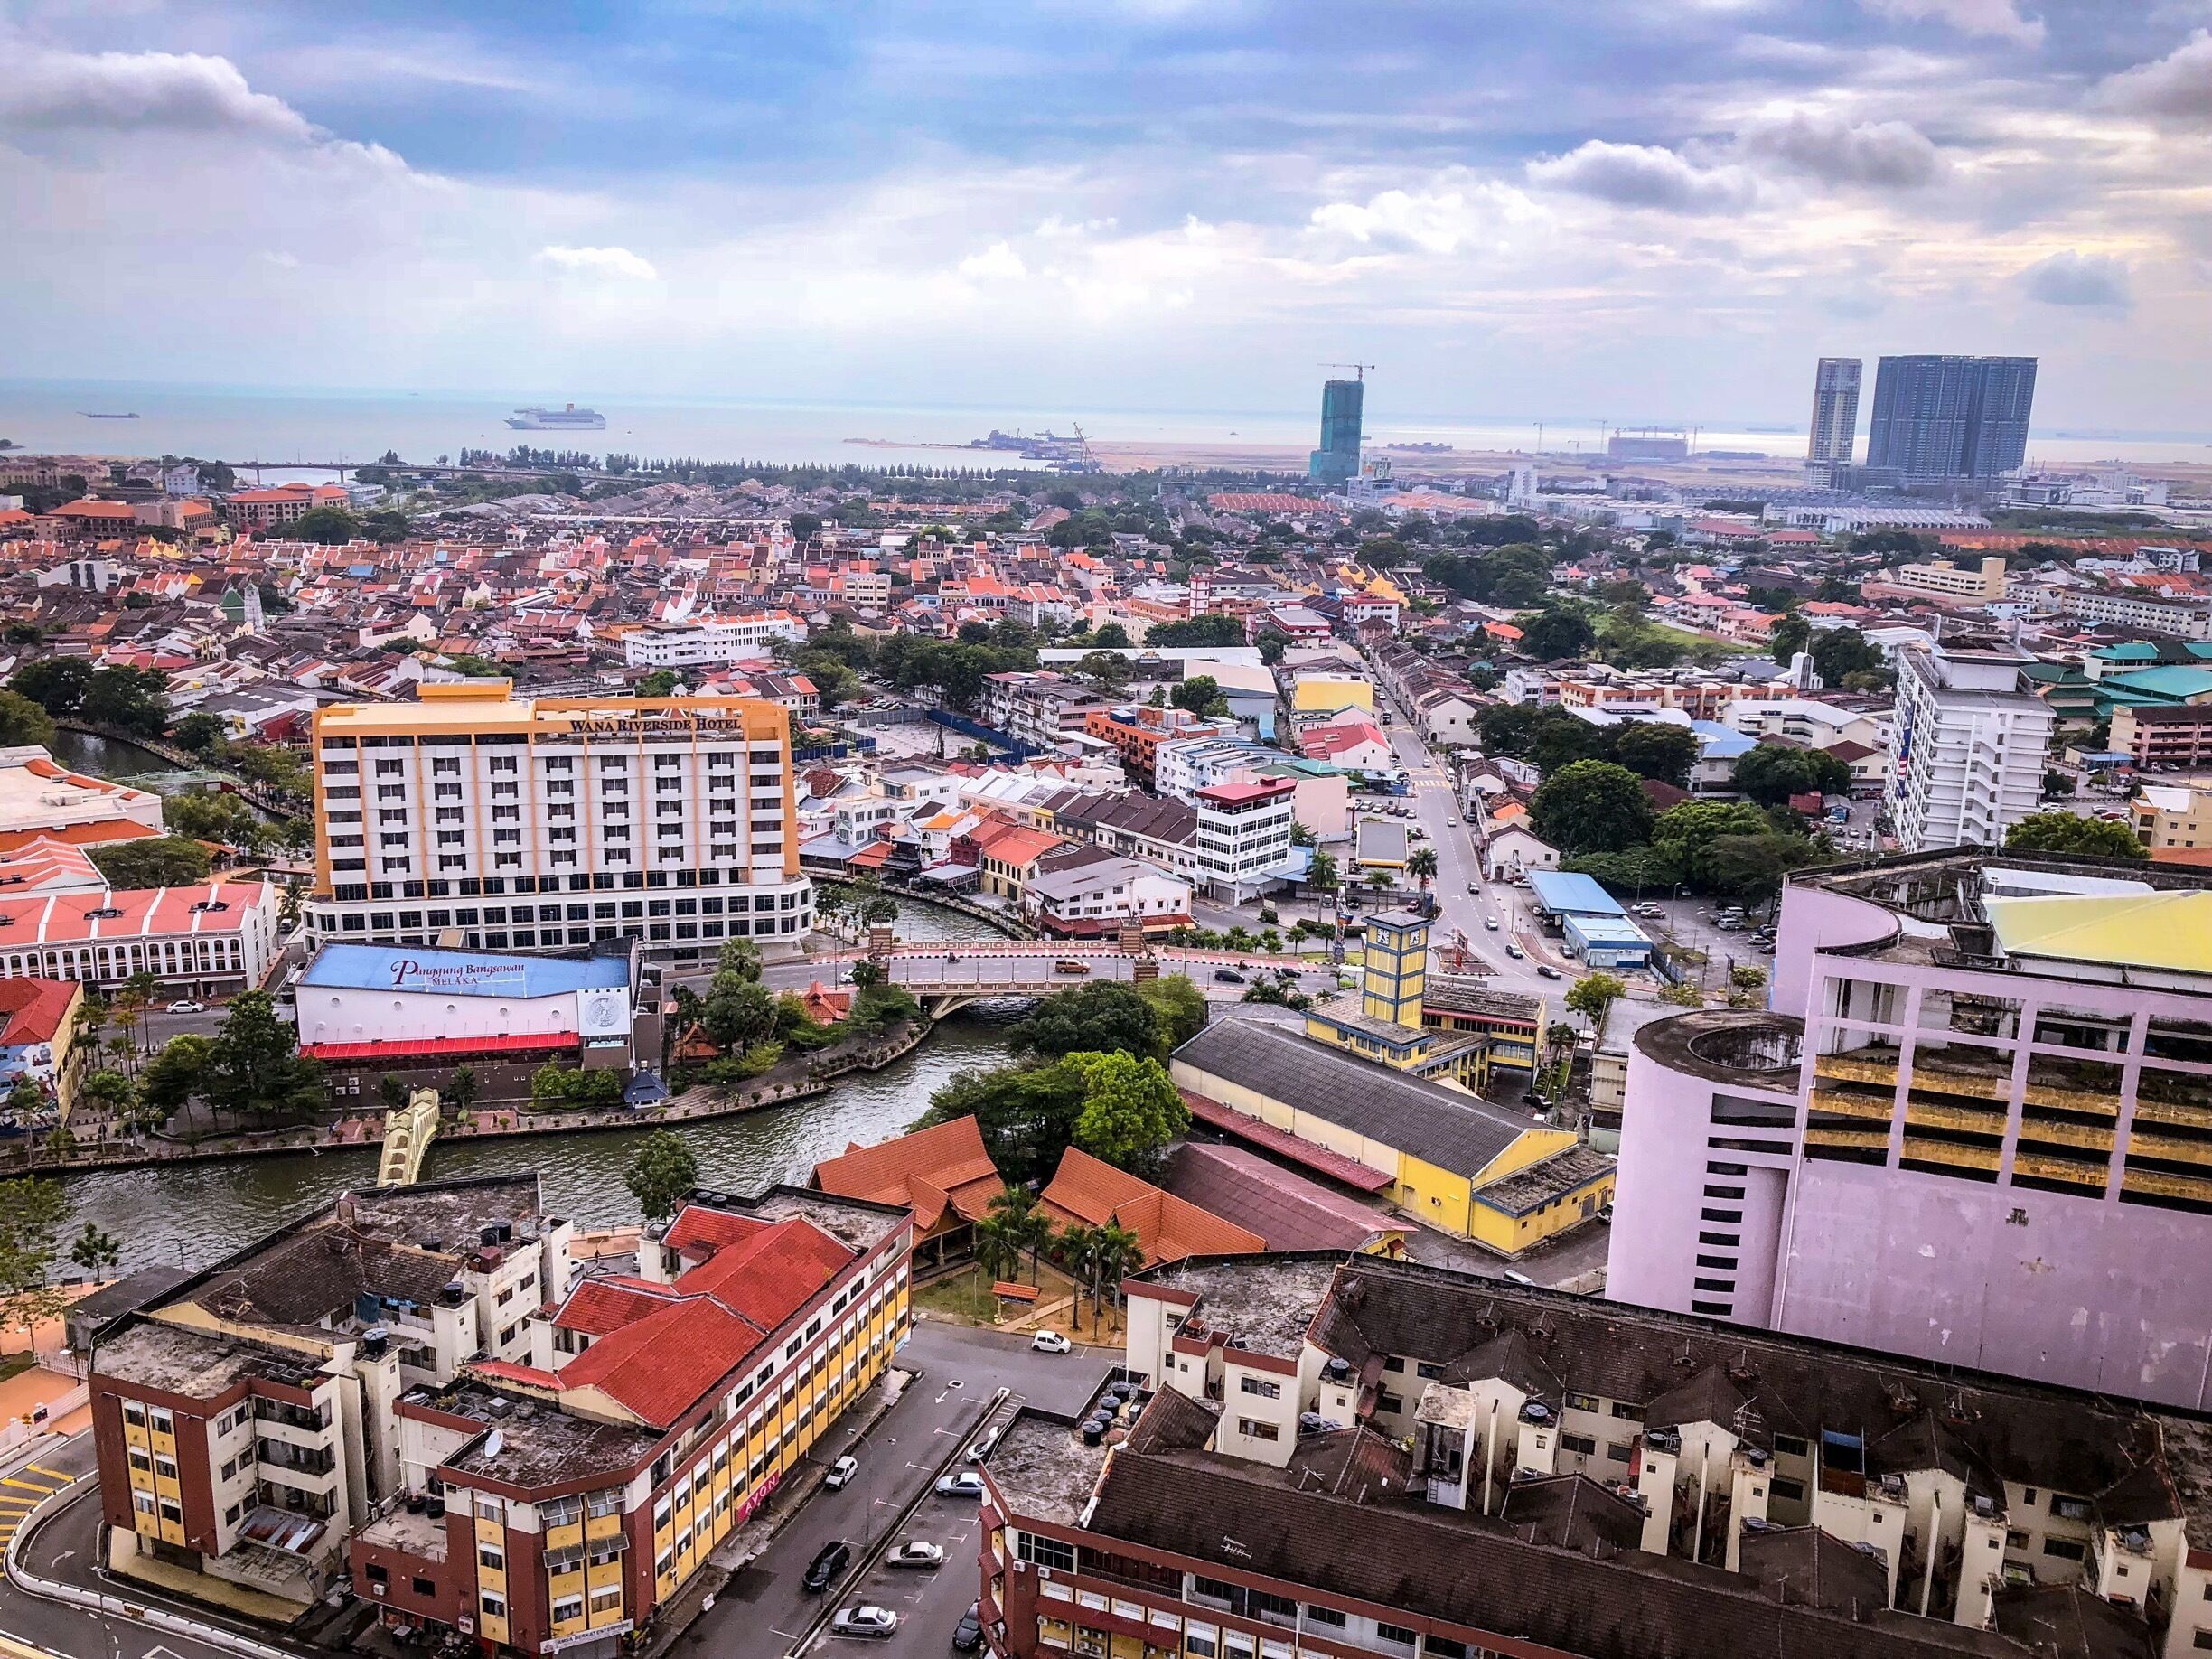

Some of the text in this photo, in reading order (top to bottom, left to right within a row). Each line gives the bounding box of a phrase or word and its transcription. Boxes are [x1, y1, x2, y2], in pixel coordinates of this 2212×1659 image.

[390, 960, 525, 985] Panggung Bangsawan
[432, 977, 478, 986] MELAKA
[745, 1476, 775, 1514] AVON
